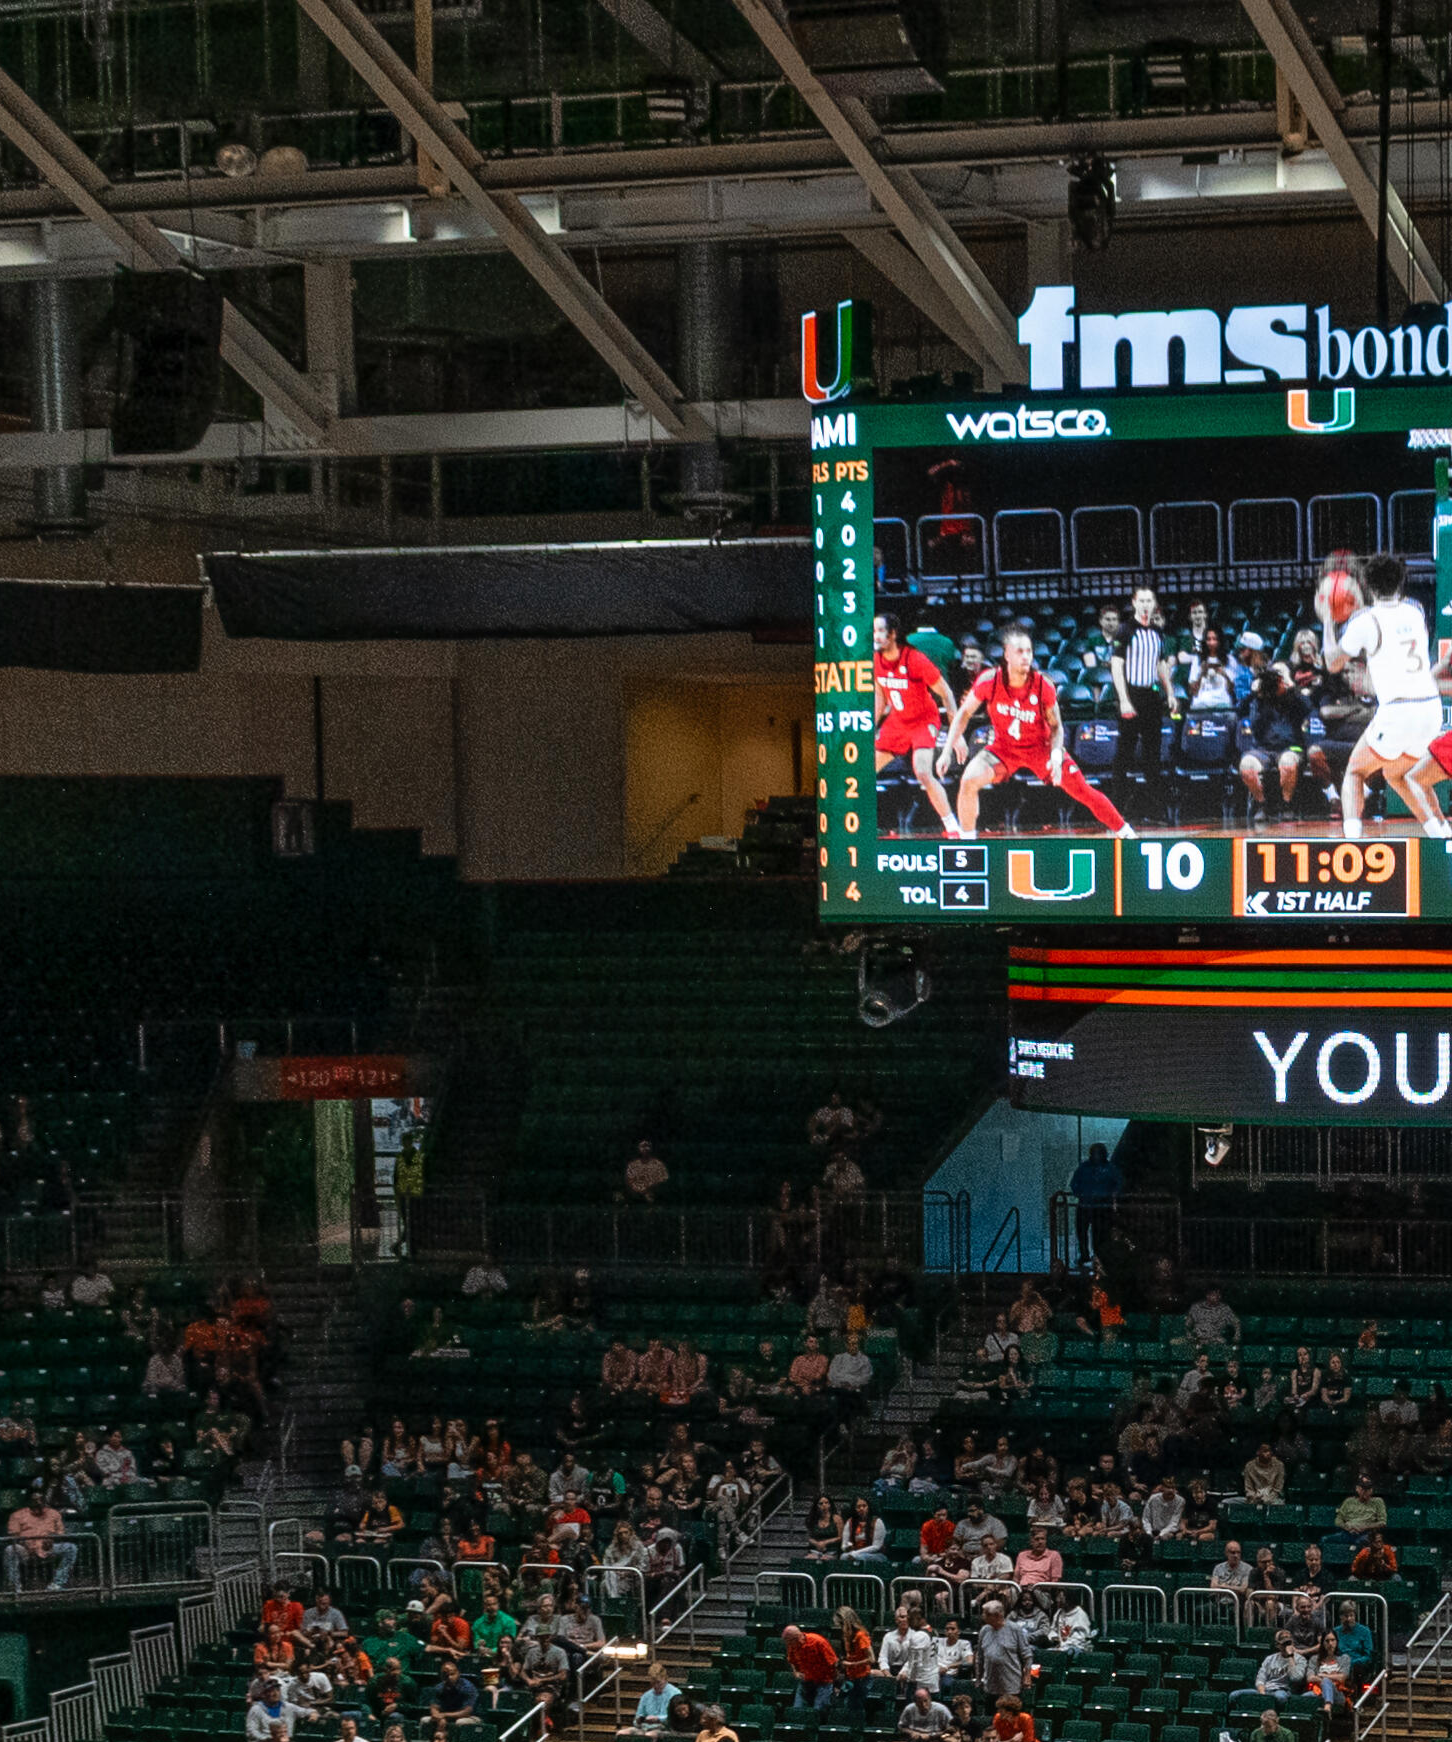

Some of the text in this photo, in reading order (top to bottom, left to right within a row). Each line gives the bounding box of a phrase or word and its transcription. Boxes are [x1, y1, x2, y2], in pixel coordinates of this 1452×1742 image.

[834, 459, 868, 482] PTS
[840, 491, 857, 513] 4
[841, 524, 856, 547] 0
[842, 558, 857, 581] 2
[842, 591, 857, 613] 3
[842, 624, 858, 647] 0
[839, 711, 873, 732] PTS
[844, 742, 858, 764] 0
[845, 777, 859, 798] 2
[845, 811, 859, 833] 0
[877, 851, 968, 873] FOULS 5
[1141, 842, 1205, 890] 10
[1256, 843, 1396, 884] 11:09
[845, 881, 861, 901] 4
[900, 887, 969, 904] TOL 4
[1276, 892, 1371, 911] 1ST HALF
[299, 1071, 330, 1088] 120
